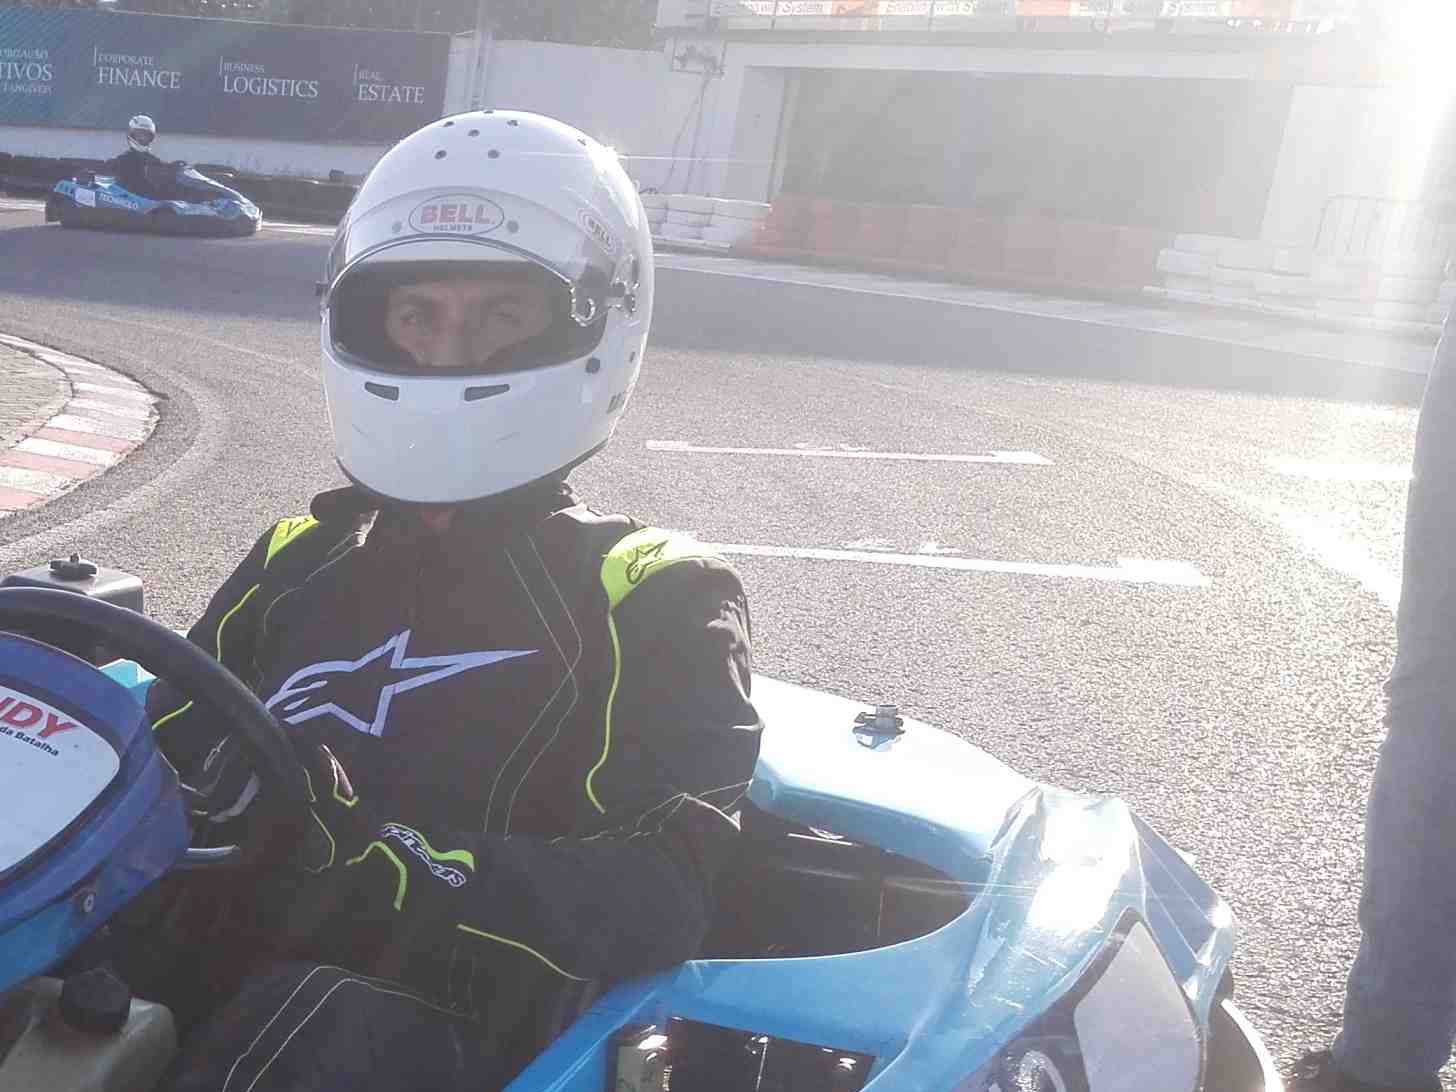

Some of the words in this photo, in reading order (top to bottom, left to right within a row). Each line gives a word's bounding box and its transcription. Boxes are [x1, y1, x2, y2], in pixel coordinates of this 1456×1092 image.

[97, 66, 182, 89] FINANCE
[223, 75, 319, 98] LOGISTICS
[358, 84, 425, 104] ESTATE
[421, 204, 492, 224] BELL
[0, 725, 14, 737] da
[15, 730, 60, 757] Batalha
